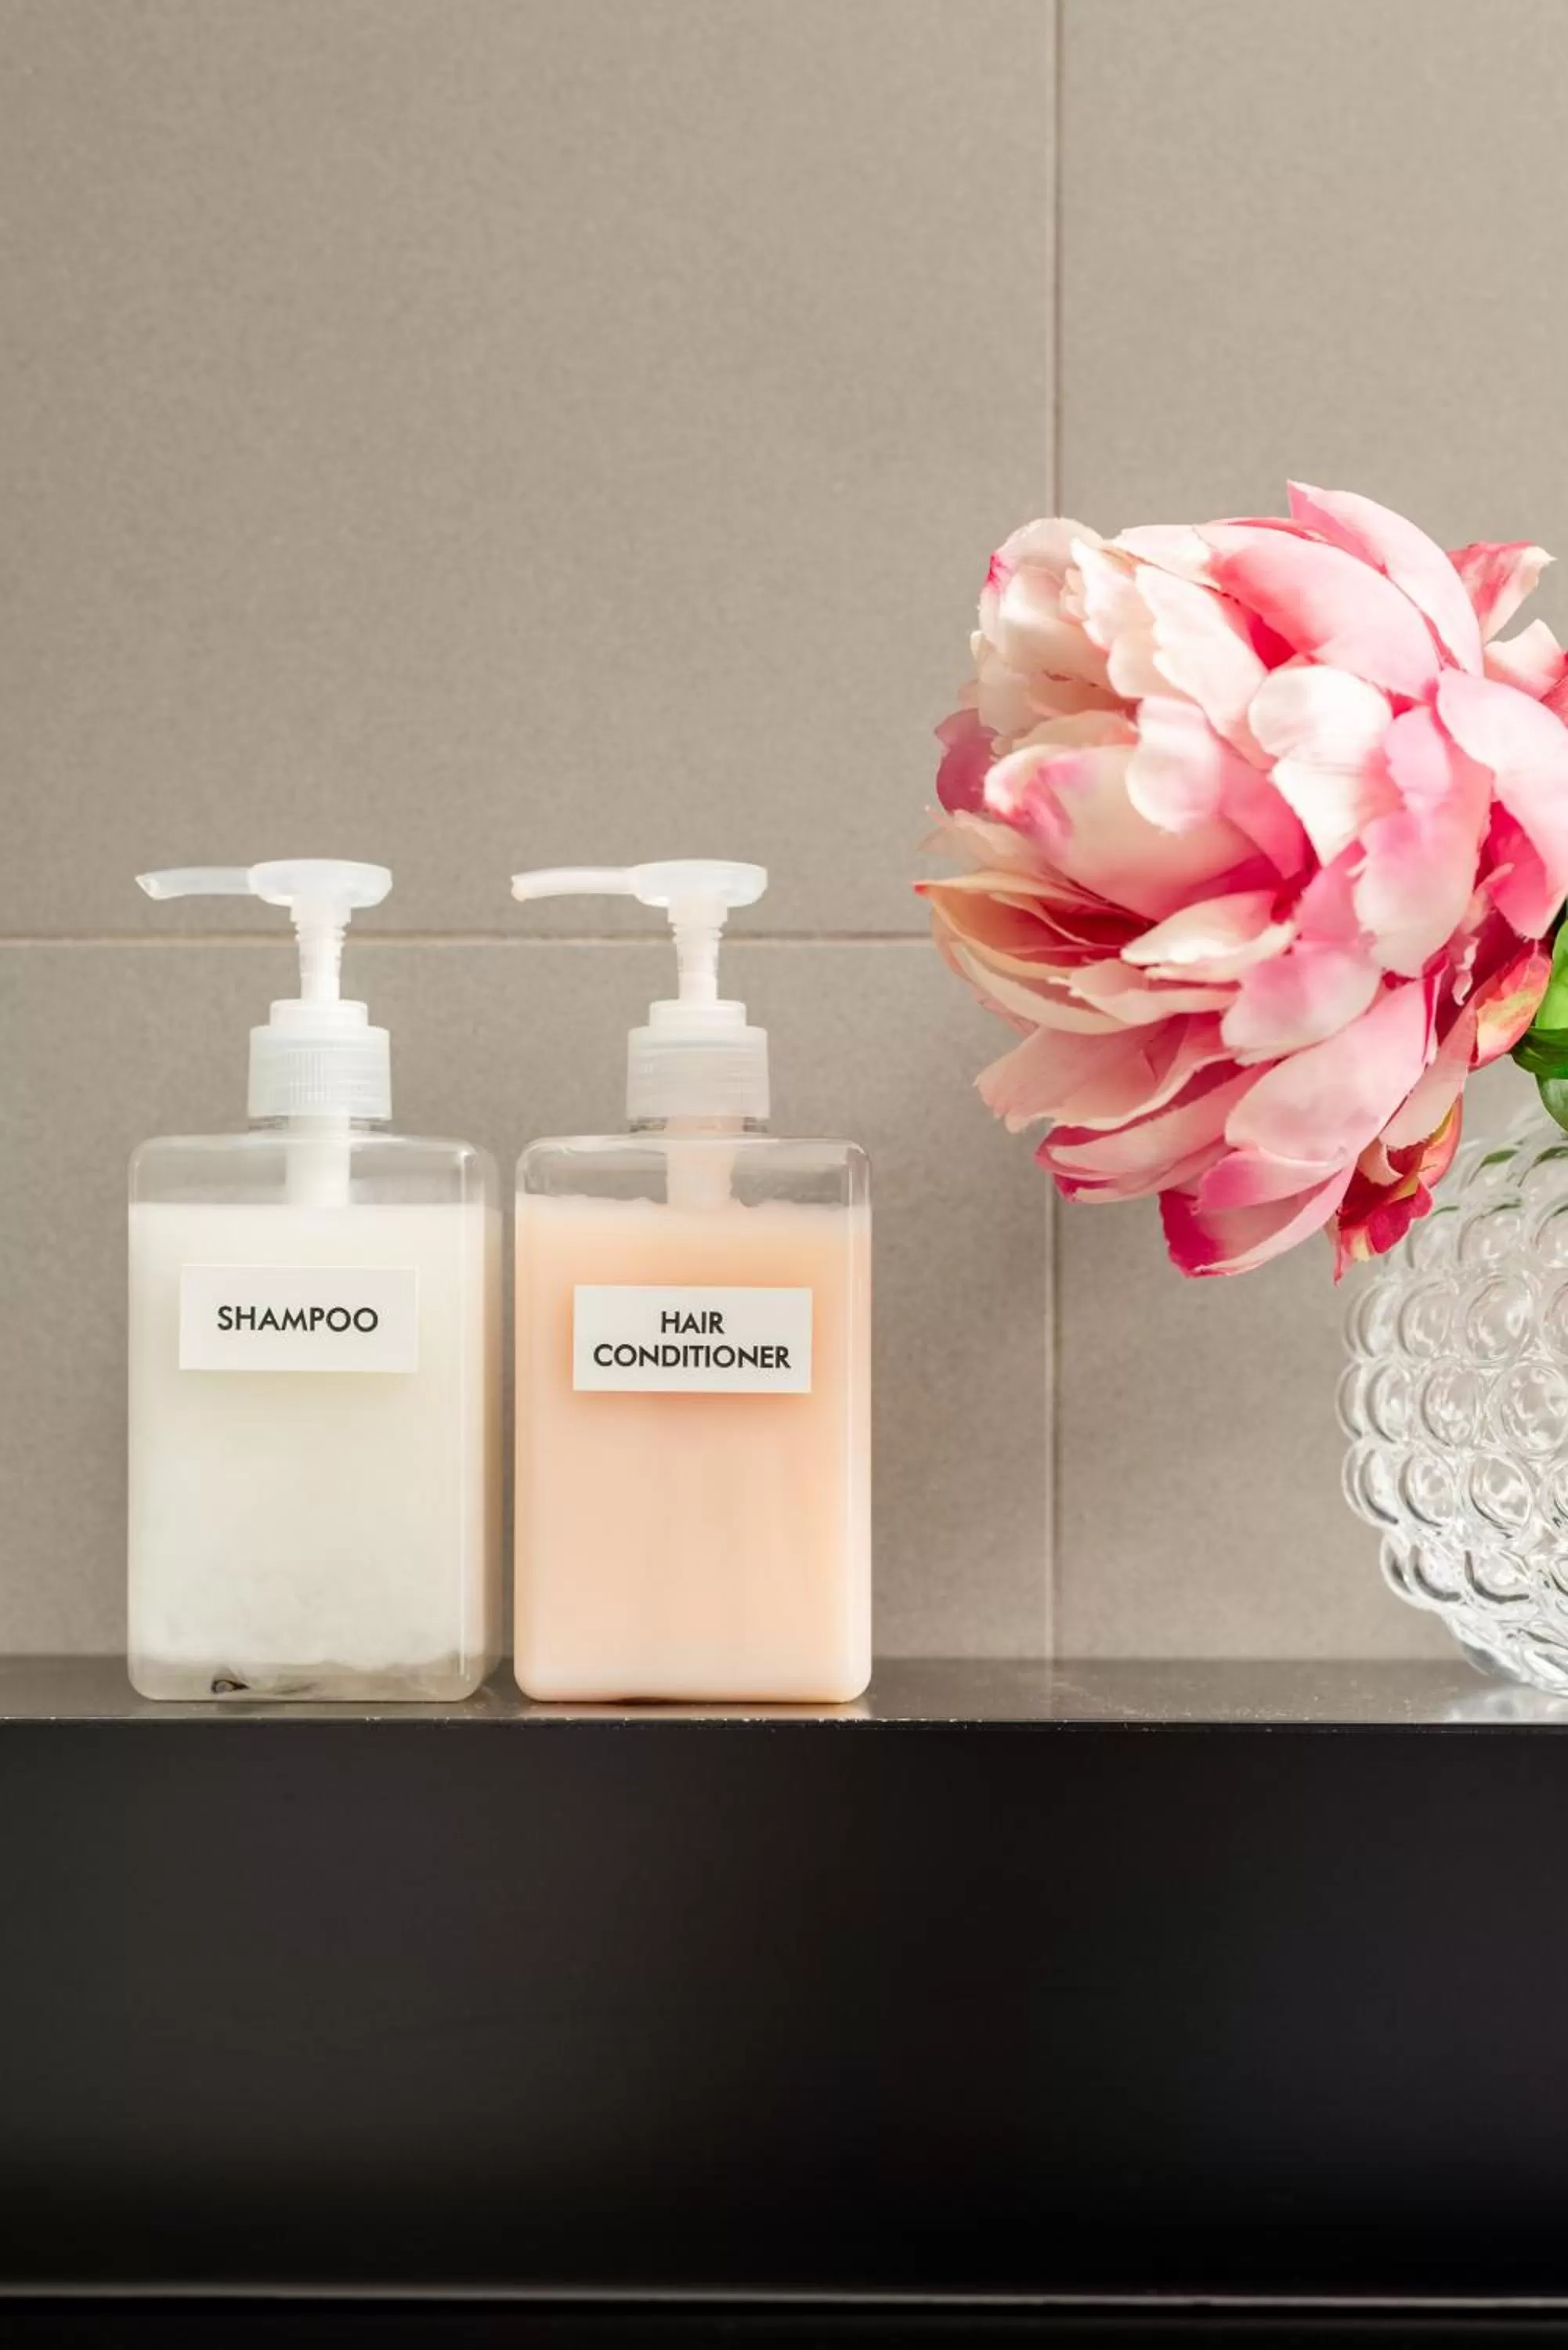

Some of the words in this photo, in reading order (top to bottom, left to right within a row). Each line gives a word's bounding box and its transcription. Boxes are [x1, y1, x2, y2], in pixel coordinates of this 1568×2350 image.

[217, 1305, 378, 1332] SHAMPOO
[660, 1311, 724, 1335] HAIR
[593, 1343, 791, 1368] CONDITIONER
